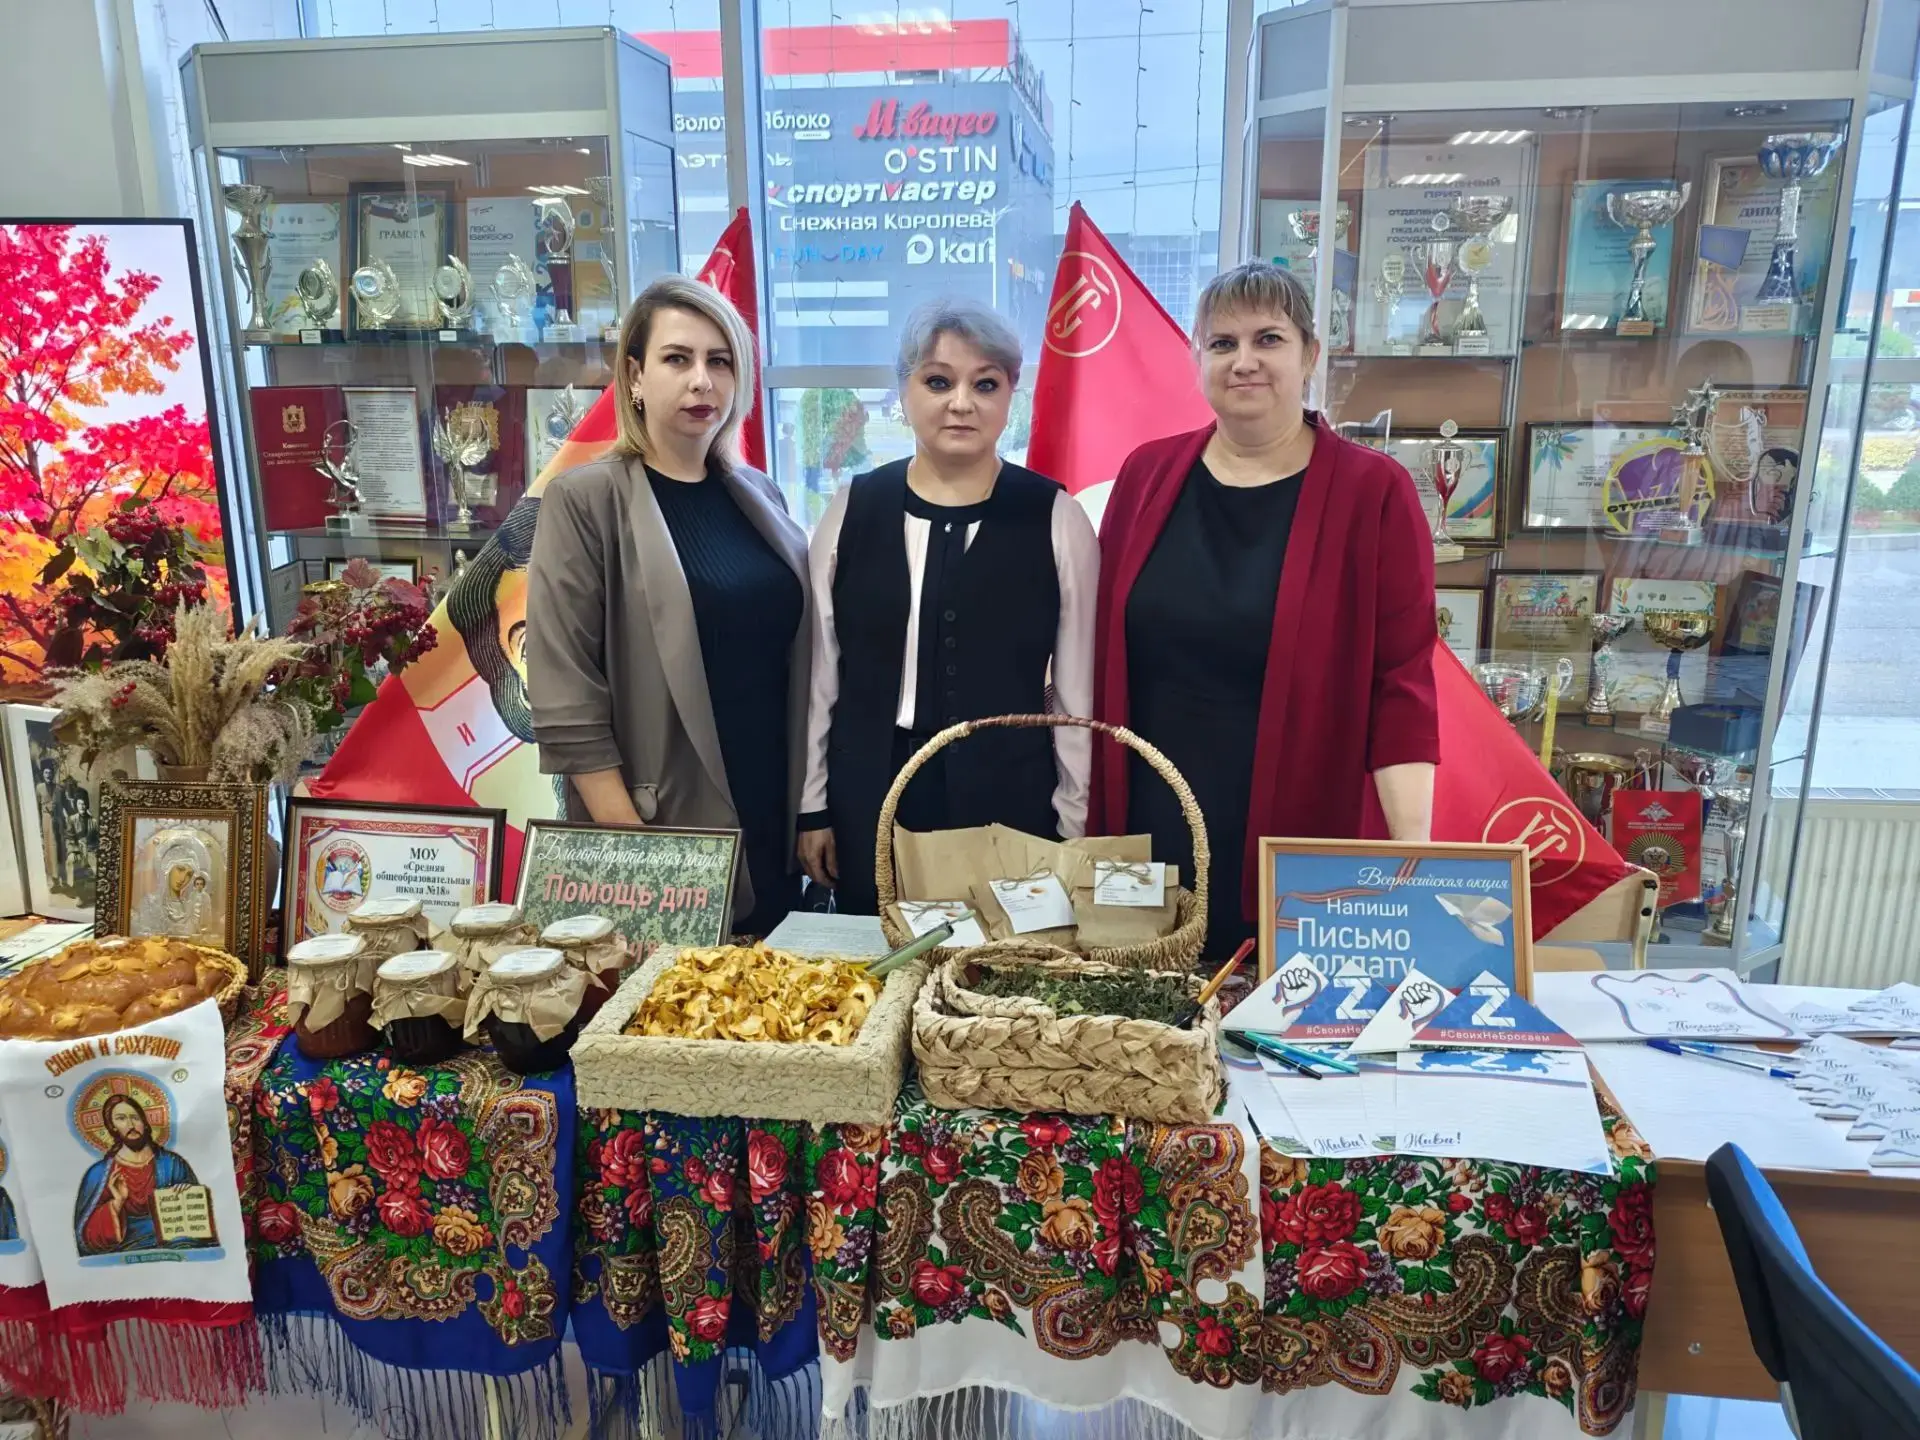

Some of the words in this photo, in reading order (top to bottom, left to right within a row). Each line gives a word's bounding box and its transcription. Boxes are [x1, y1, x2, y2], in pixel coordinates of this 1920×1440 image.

[674, 113, 727, 132] Золот
[885, 146, 997, 174] O'STIN
[1738, 205, 1803, 218] ДИПЛ
[780, 214, 878, 232] Снежная
[884, 213, 995, 231] Королева
[410, 847, 439, 861] МОУ
[375, 872, 471, 886] общеобразовательная
[1357, 866, 1464, 892] Всероссийская
[1466, 878, 1509, 892] акция
[395, 886, 424, 895] школа
[543, 873, 655, 912] Помощь
[658, 886, 710, 913] для
[1326, 897, 1409, 917] Напиши
[1297, 917, 1412, 951] Письмо
[1303, 953, 1417, 979] олдату
[1306, 1025, 1366, 1036] #СвоихНе
[1440, 1029, 1551, 1043] #СвоихНеБросаем
[44, 1040, 97, 1077] СПАСИ
[97, 1037, 111, 1057] И
[114, 1034, 184, 1061] СОХРАНИ
